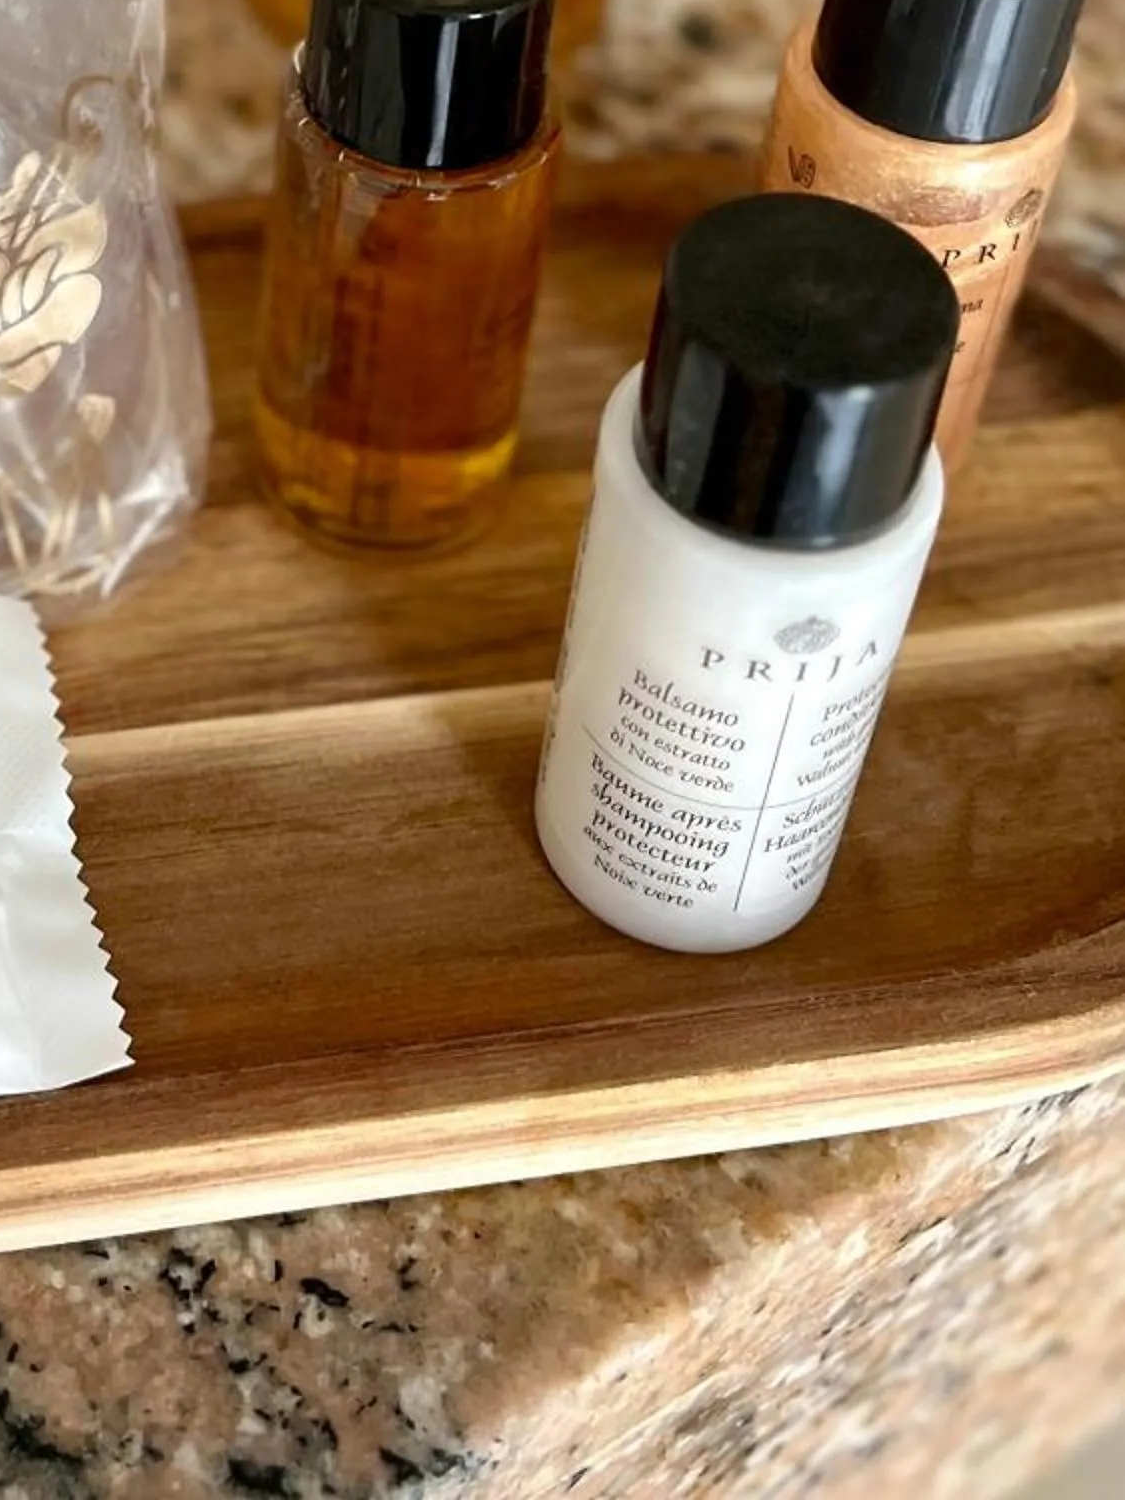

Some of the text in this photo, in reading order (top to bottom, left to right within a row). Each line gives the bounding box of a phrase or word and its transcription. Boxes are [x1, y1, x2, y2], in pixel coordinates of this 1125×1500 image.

[699, 640, 879, 683] PRIJA
[618, 686, 746, 752] protettivo
[633, 669, 739, 727] Balsamo
[610, 727, 735, 793] di Noce verde
[620, 715, 730, 771] con estratto
[590, 782, 731, 858] shampooing
[591, 752, 743, 833] Baume après
[583, 825, 718, 893] aux extraits de
[591, 809, 717, 873] protecteur
[594, 854, 694, 908] Noix verte
